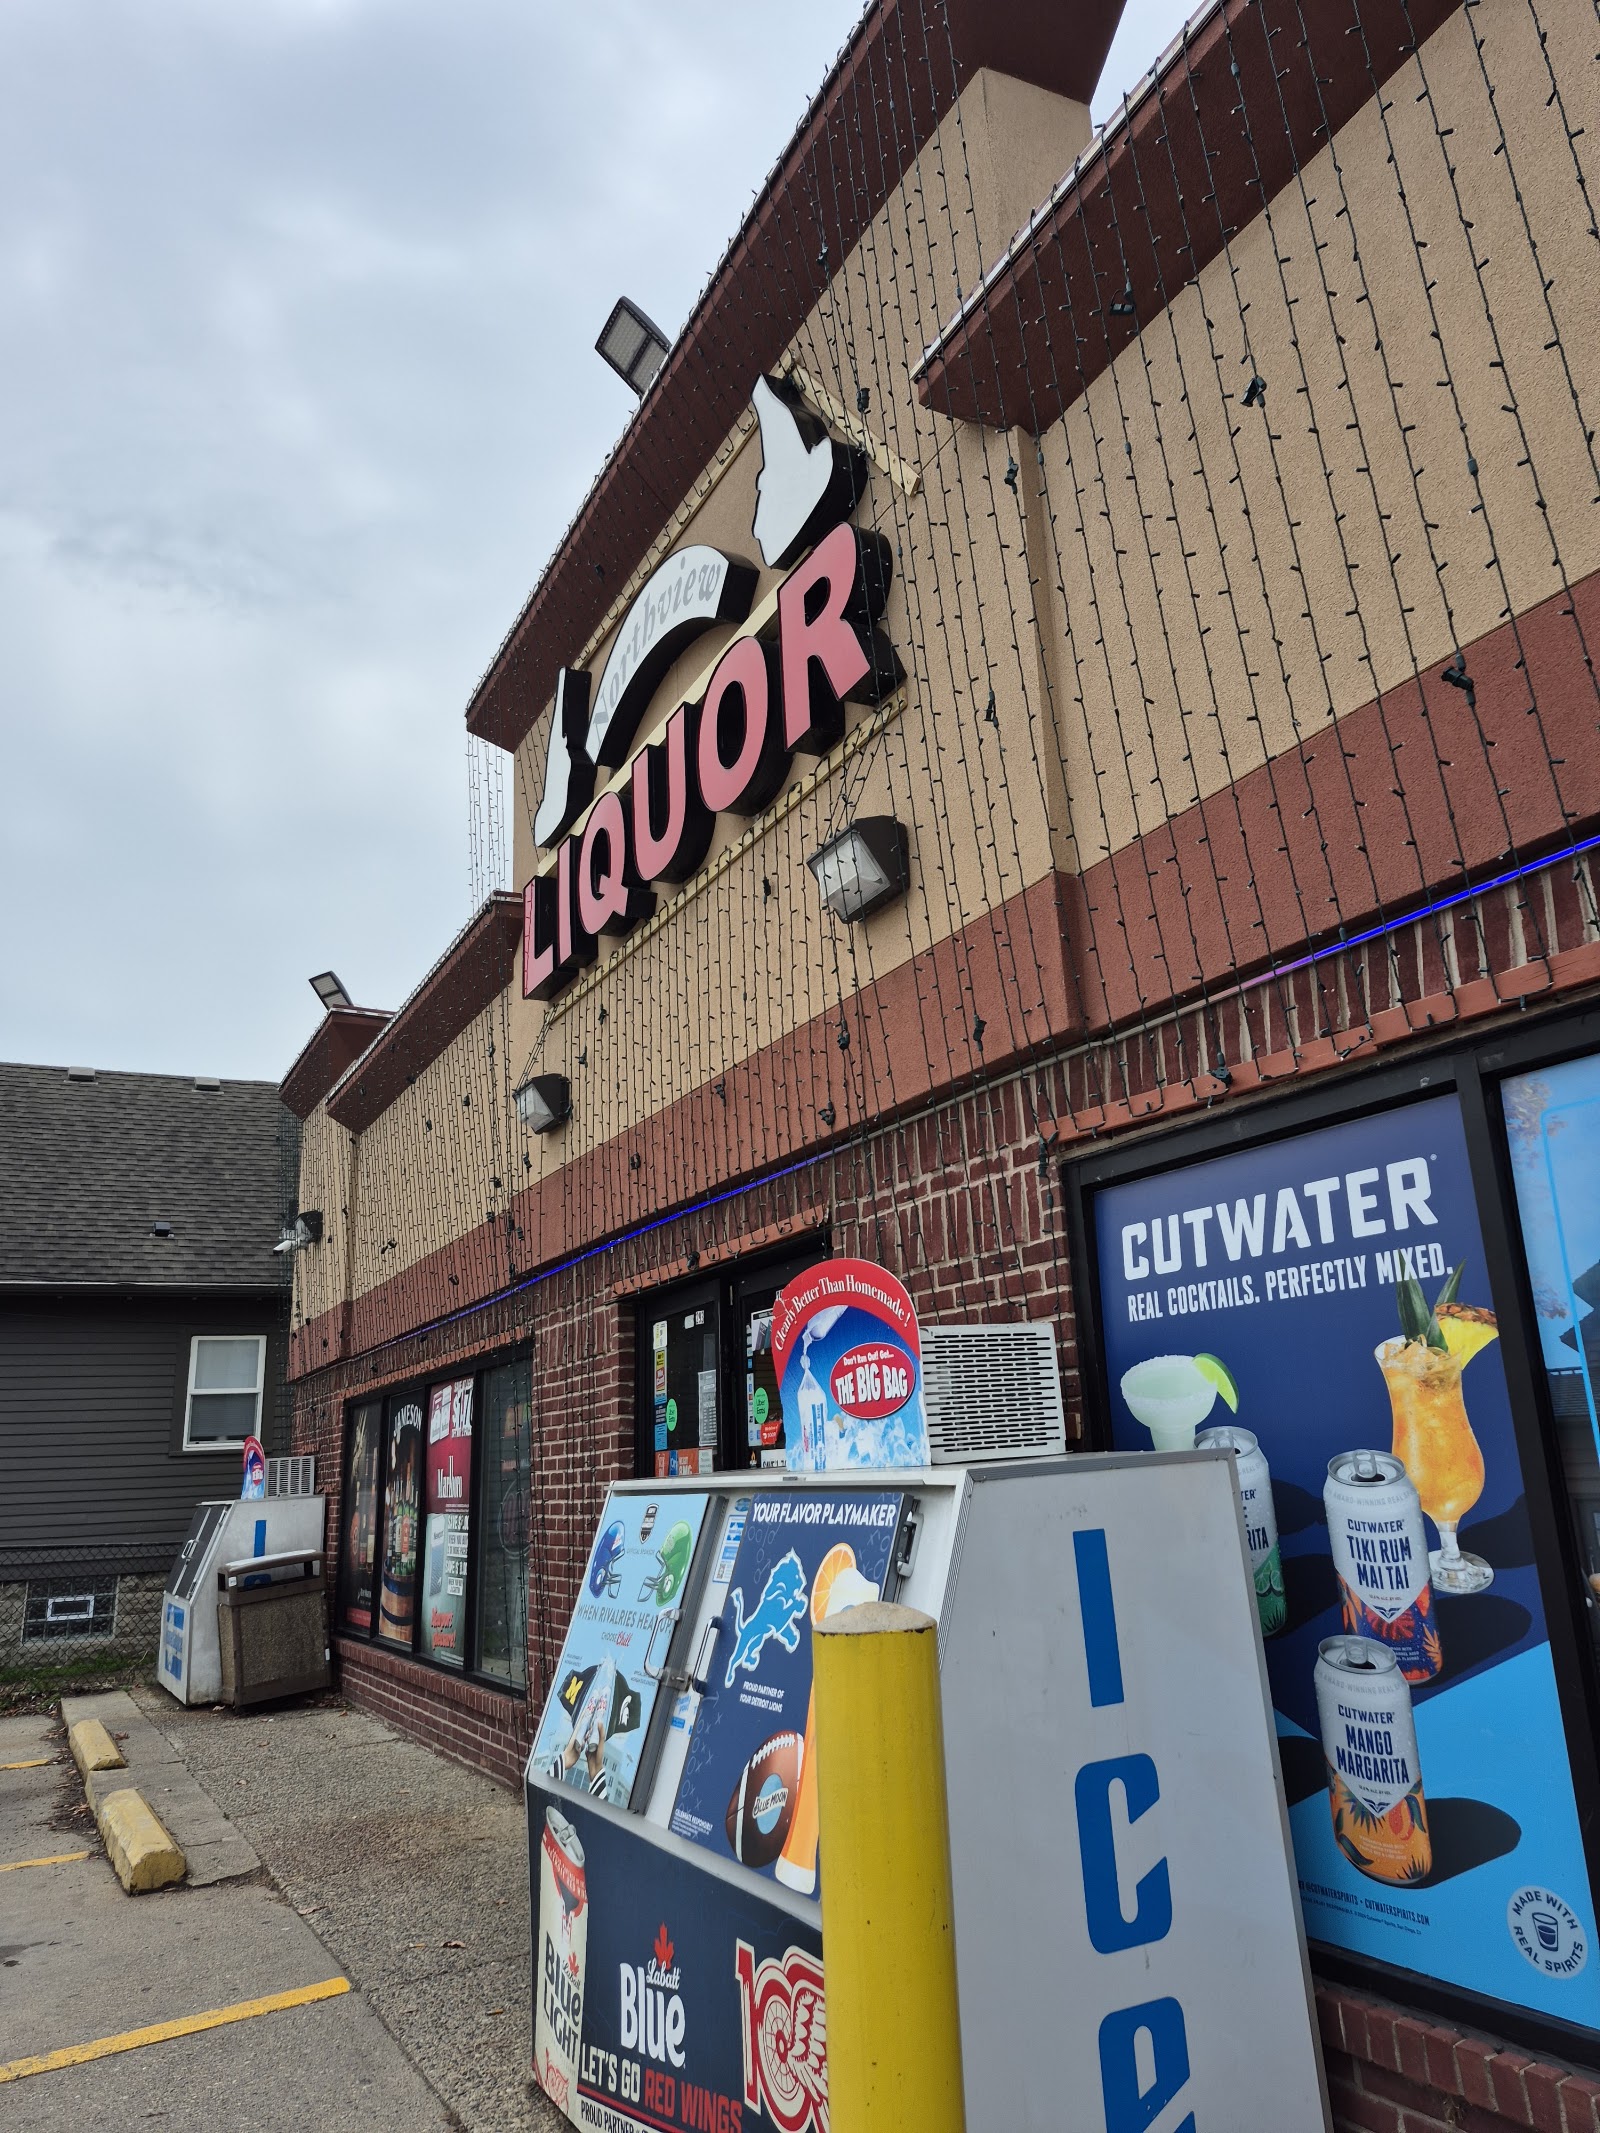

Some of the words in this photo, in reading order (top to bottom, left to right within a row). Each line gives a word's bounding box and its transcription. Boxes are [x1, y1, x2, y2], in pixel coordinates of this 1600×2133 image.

[523, 521, 872, 1000] LIQUOR
[1127, 1290, 1163, 1322] REAL
[1167, 1275, 1260, 1316] COCKTAILS.
[1265, 1255, 1366, 1302] PERFECTLY
[1375, 1243, 1453, 1285] MIXED.
[775, 1308, 797, 1352] Clearly
[791, 1286, 820, 1313] Better
[819, 1276, 845, 1296] Than
[843, 1356, 857, 1366] Don't
[835, 1372, 855, 1405] THE
[856, 1363, 881, 1403] BIG
[882, 1365, 908, 1400] BAG
[393, 1404, 423, 1437] JAMESON
[437, 1455, 463, 1499] Marlboro
[752, 1502, 781, 1523] YOUR
[780, 1503, 824, 1524] FLAVOR
[821, 1504, 896, 1528] PLAYMAKER
[1347, 1519, 1403, 1534] CUTWATER
[1346, 1535, 1377, 1562] TIKI
[1379, 1536, 1412, 1563] RUM
[1357, 1562, 1384, 1590] MAI
[1386, 1564, 1410, 1590] TAI
[577, 1605, 598, 1621] WHEN
[600, 1607, 636, 1629] RIVALRIES
[637, 1612, 655, 1631] HEA
[739, 1693, 751, 1704] YOUR
[751, 1697, 769, 1709] DETROIT
[769, 1701, 783, 1713] LIONS
[743, 1681, 758, 1693] PROUD
[758, 1684, 778, 1698] PARTNER
[777, 1690, 785, 1699] OF
[1338, 1704, 1393, 1724] CUTWATER
[1345, 1723, 1393, 1756] MANGO
[1336, 1745, 1410, 1784] MARGARITA
[1365, 1898, 1431, 1927] CUTWATERSPIRITS.COM
[1512, 1890, 1542, 1916] MADE
[1546, 1893, 1578, 1930] WITH
[1513, 1926, 1540, 1964] REAL
[1545, 1941, 1583, 1973] SPIRITS
[545, 1930, 581, 2027] Blue
[646, 1957, 682, 1991] Labatt
[544, 1976, 579, 2065] LIGHT
[619, 1962, 686, 2068] Blue
[581, 2043, 618, 2093] LET'S
[621, 2059, 641, 2103] GO
[645, 2068, 675, 2118] RED
[681, 2081, 743, 2133] WINGS
[580, 2099, 603, 2129] PROUD
[604, 2111, 634, 2133] PARTNER
